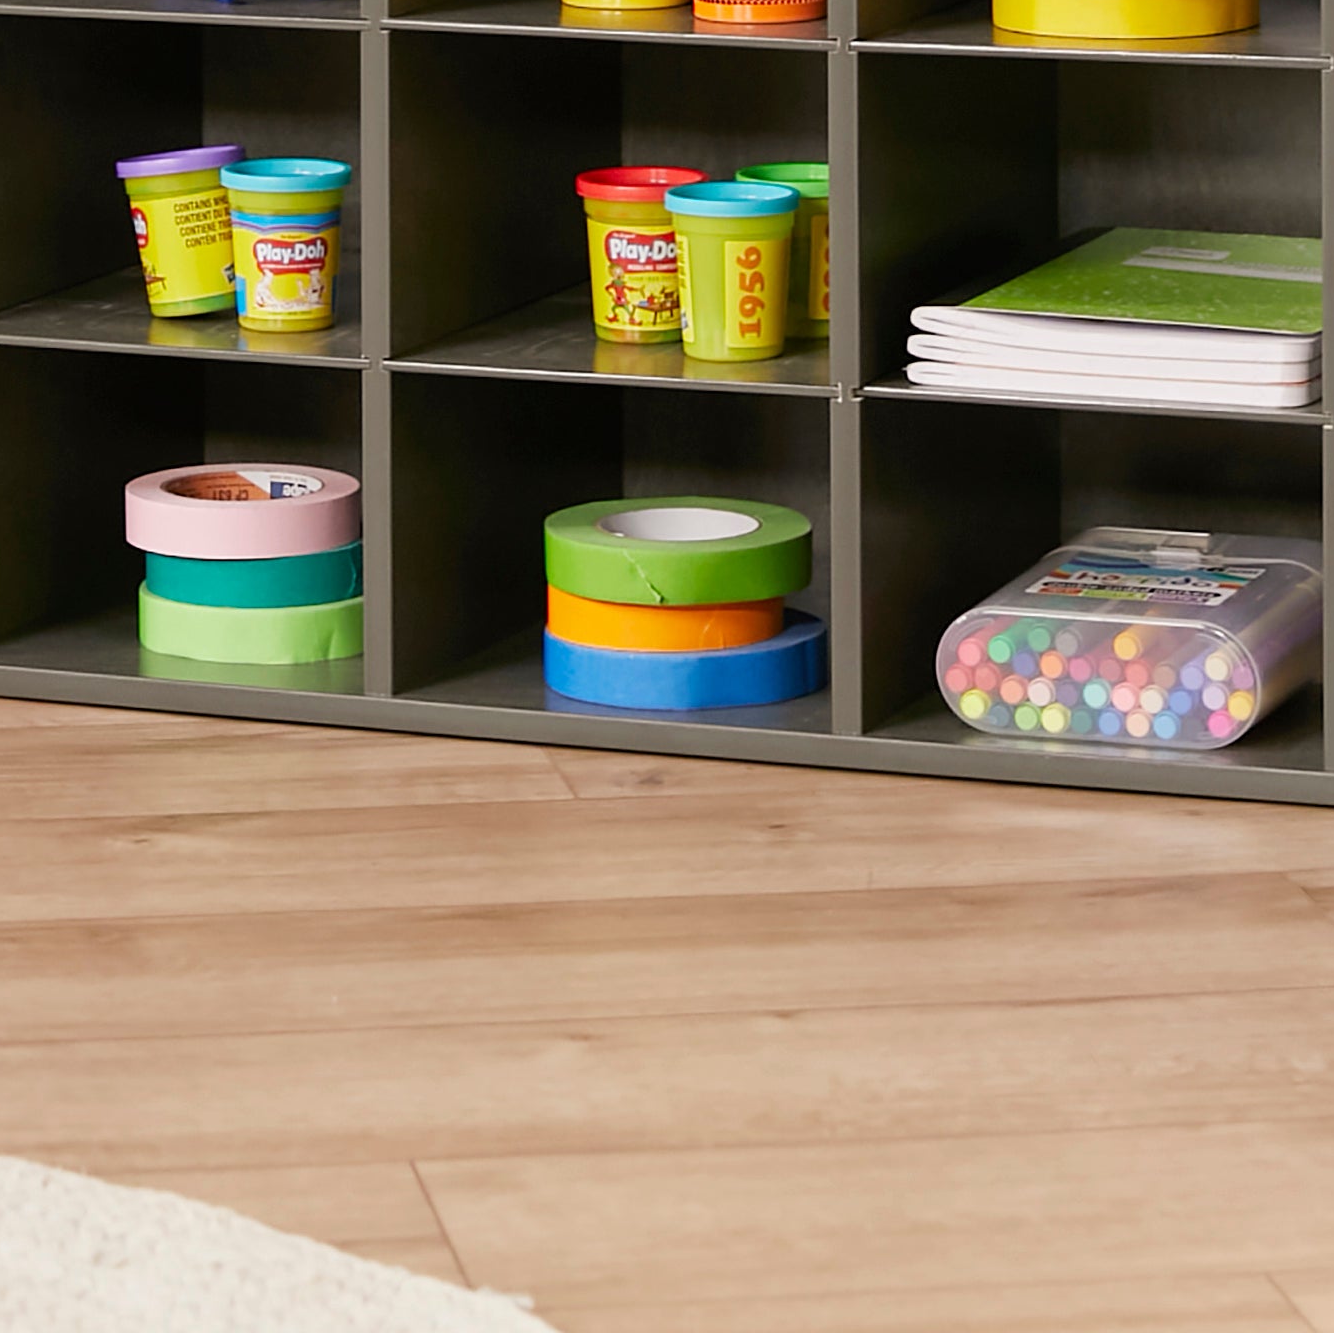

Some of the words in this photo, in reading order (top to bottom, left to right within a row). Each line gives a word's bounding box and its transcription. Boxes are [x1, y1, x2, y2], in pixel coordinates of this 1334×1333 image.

[173, 198, 212, 213] CONTAINS
[174, 210, 212, 226] CONTIENT
[179, 221, 217, 237] CONTIENE
[255, 238, 325, 264] Play-Doh
[609, 238, 677, 264] Play-Do
[736, 245, 765, 339] 1956
